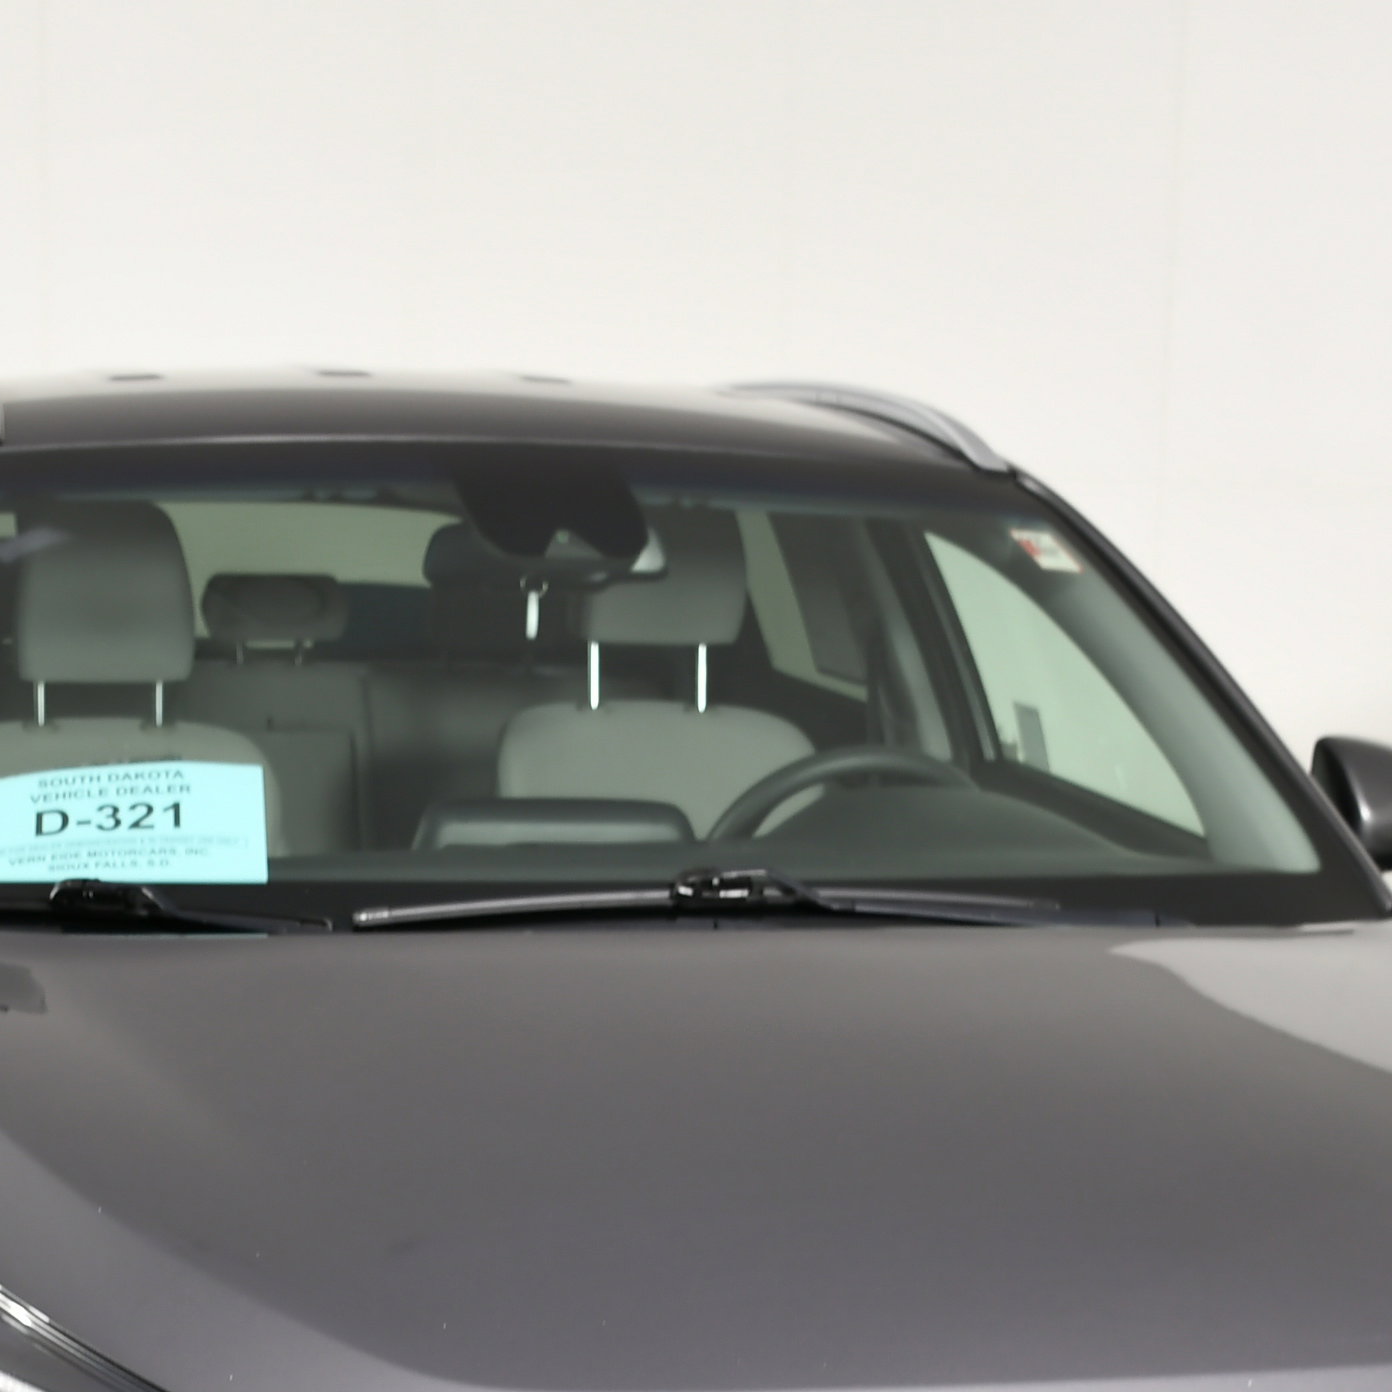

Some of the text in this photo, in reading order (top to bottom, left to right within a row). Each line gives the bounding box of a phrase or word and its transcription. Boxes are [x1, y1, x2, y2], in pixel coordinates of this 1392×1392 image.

[37, 769, 185, 789] SOUTH DAKOTA
[29, 783, 192, 804] VEHICLE DEALER
[34, 801, 183, 838] D-321
[8, 854, 47, 867] VERN
[48, 861, 90, 873] SIOUX
